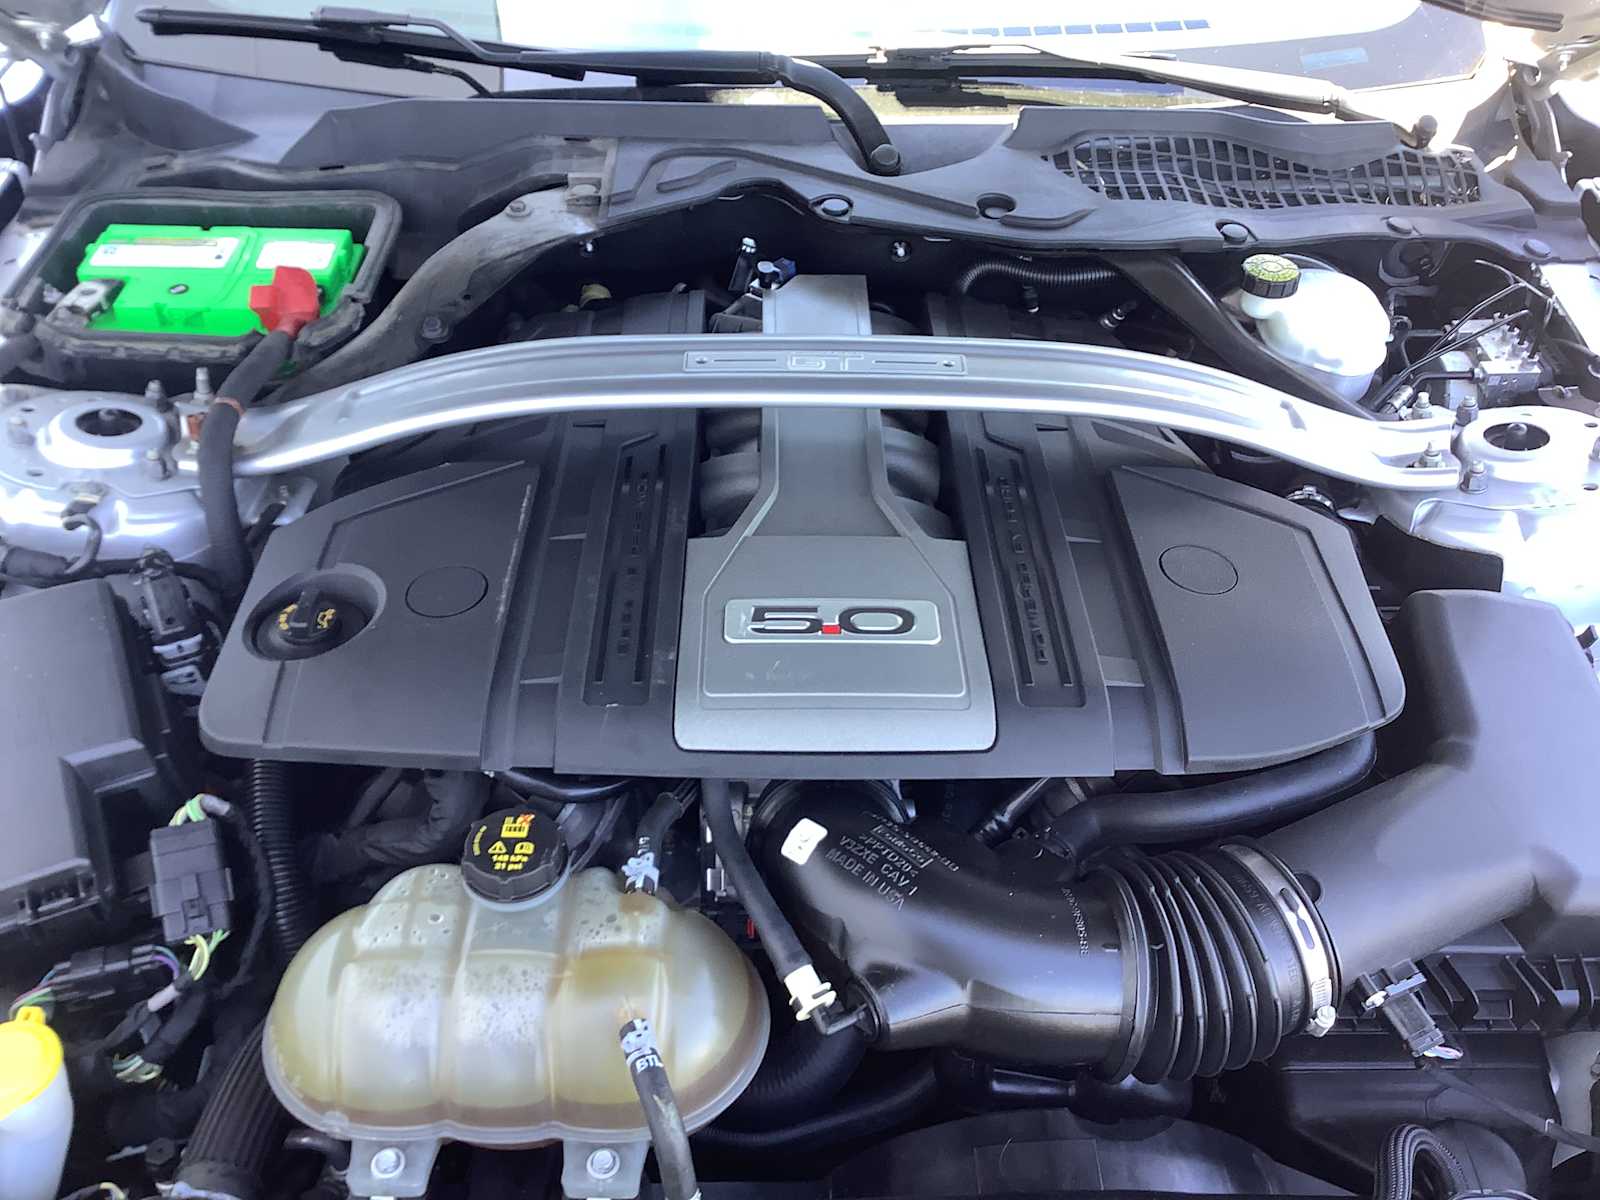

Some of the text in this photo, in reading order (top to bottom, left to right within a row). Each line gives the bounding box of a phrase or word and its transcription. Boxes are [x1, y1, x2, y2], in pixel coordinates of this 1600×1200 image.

[787, 351, 864, 371] GT
[749, 606, 916, 635] 5.0
[825, 848, 905, 911] MADE IN USA
